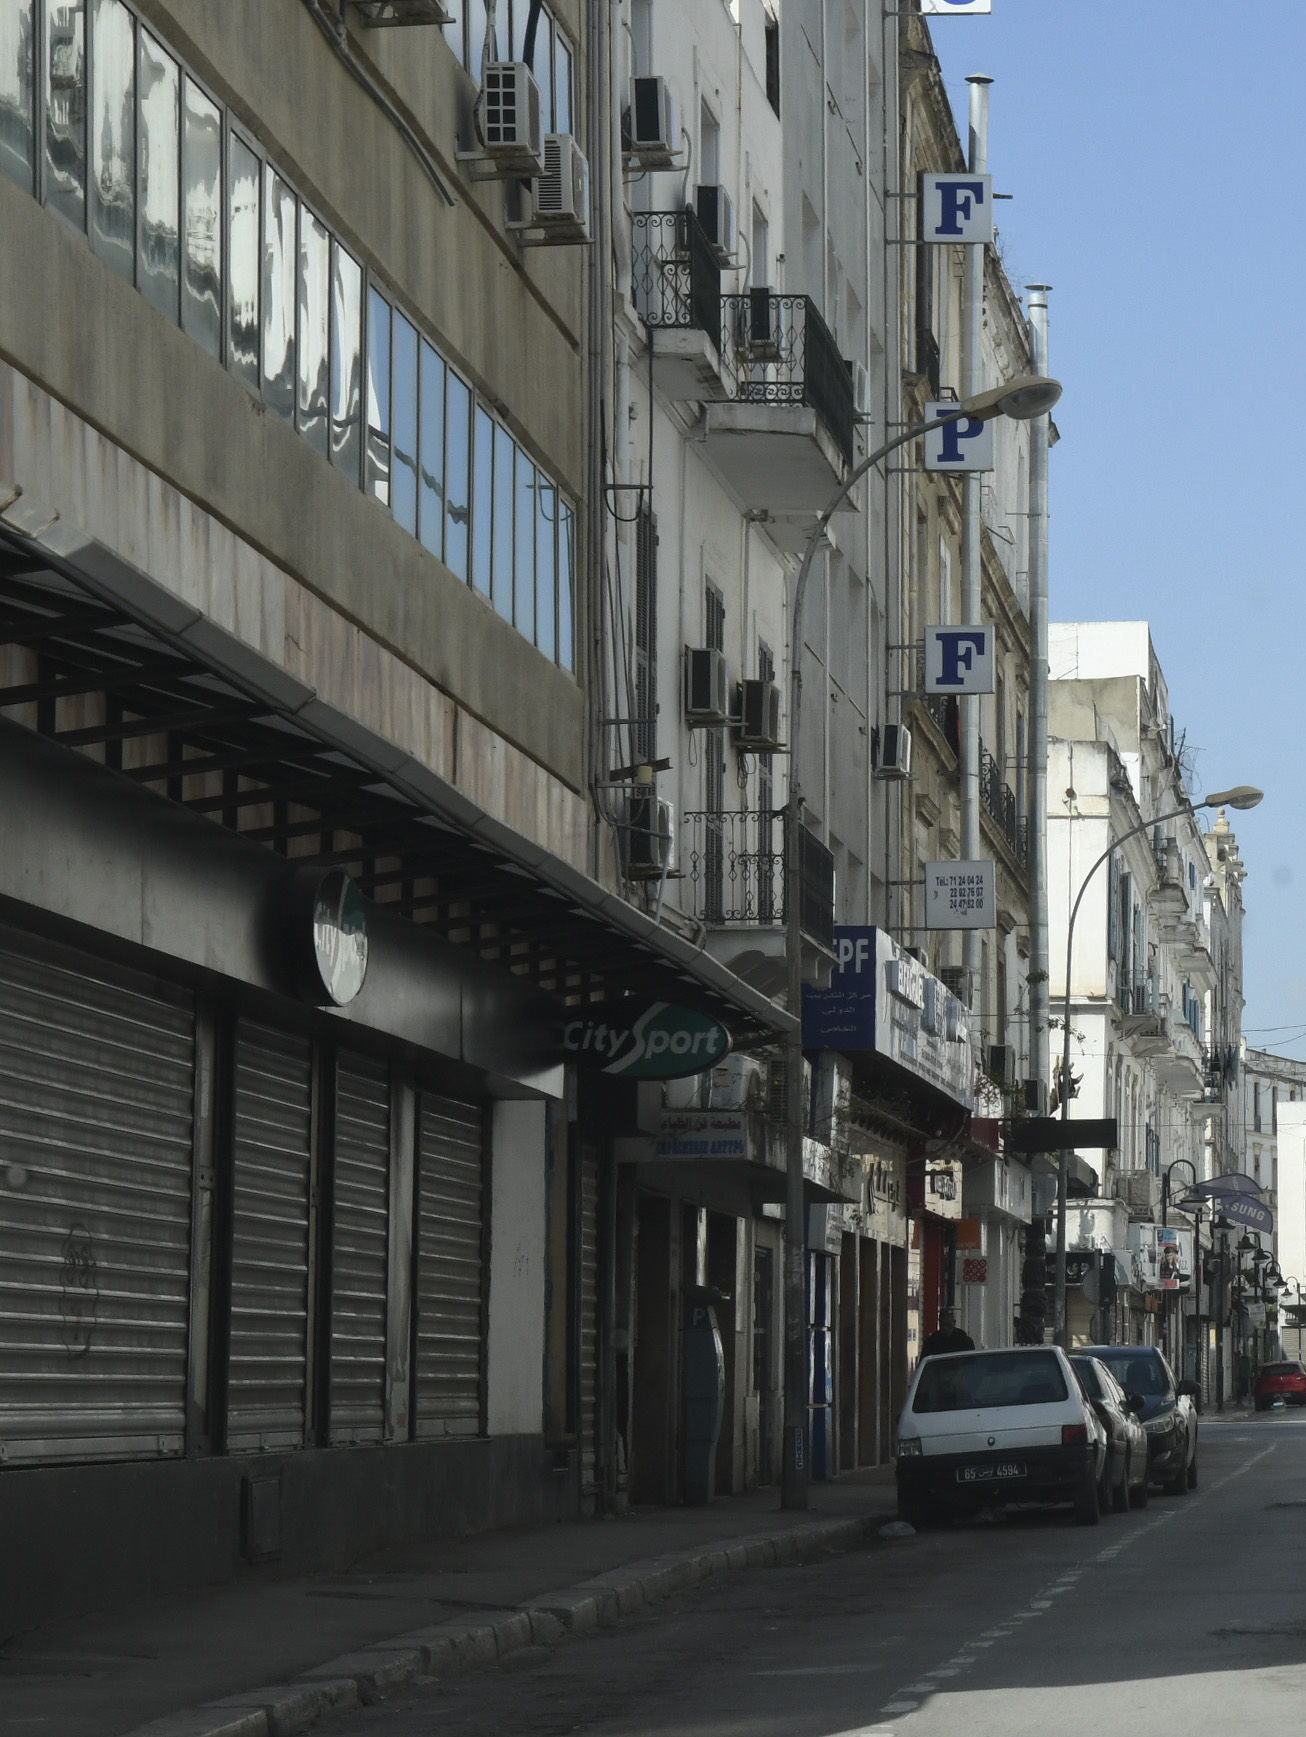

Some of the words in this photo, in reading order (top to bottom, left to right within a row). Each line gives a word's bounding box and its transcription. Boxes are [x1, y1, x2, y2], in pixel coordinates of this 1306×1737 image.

[935, 182, 984, 235] F
[936, 409, 984, 462] P
[936, 632, 985, 685] F
[949, 876, 957, 886] 71
[958, 876, 966, 886] 24
[975, 875, 984, 885] 24
[950, 888, 958, 898] 22
[975, 887, 984, 896] 07
[949, 899, 957, 909] 24
[975, 898, 984, 909] 00
[964, 1467, 976, 1480] 65
[978, 1466, 994, 1477] تونس
[996, 1464, 1019, 1477] 4594
